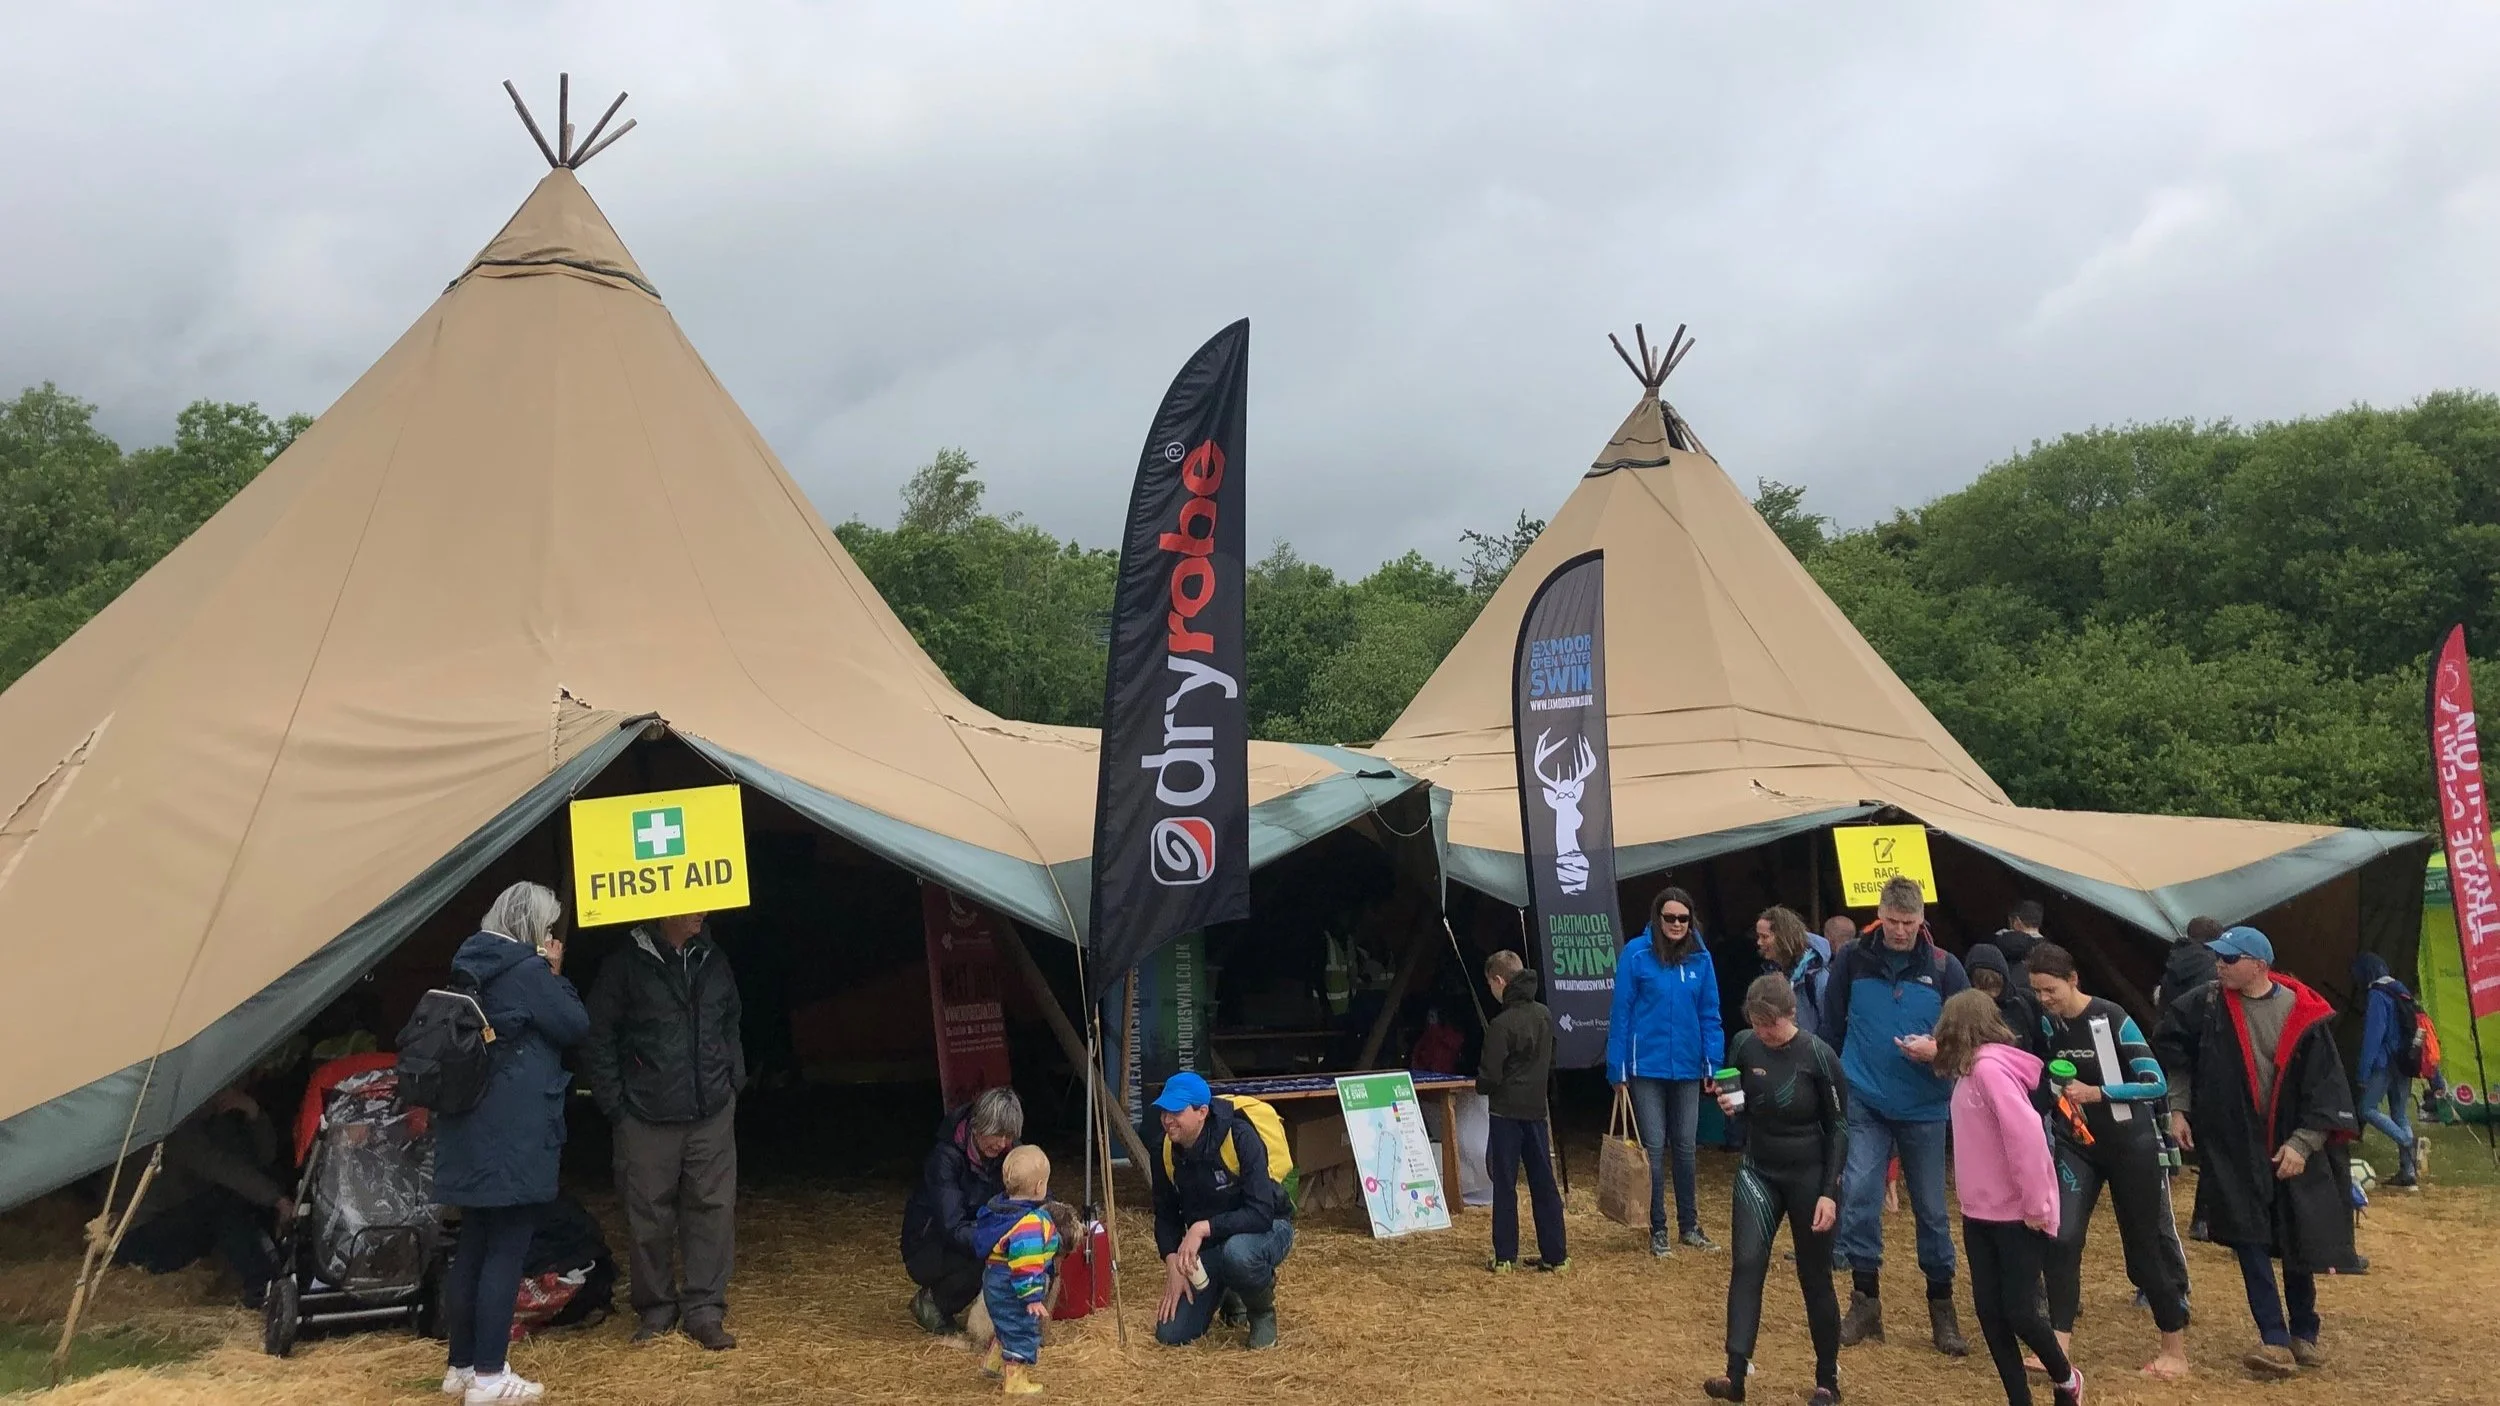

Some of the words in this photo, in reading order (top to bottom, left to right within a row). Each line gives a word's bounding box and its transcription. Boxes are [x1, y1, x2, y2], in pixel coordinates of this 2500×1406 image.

[1532, 634, 1591, 658] EXMOOR
[1531, 656, 1558, 669] OPEN
[1560, 651, 1591, 666] WATER
[1530, 664, 1592, 697] SWIM
[590, 865, 674, 900] FIRST
[685, 858, 732, 889] AID
[1874, 867, 1900, 878] RACE
[1853, 879, 1926, 893] REGISN
[1549, 913, 1611, 934] DARTMOOR
[1552, 935, 1574, 948] OPEN
[1575, 934, 1614, 948] WATER
[1553, 946, 1617, 976] SWIM
